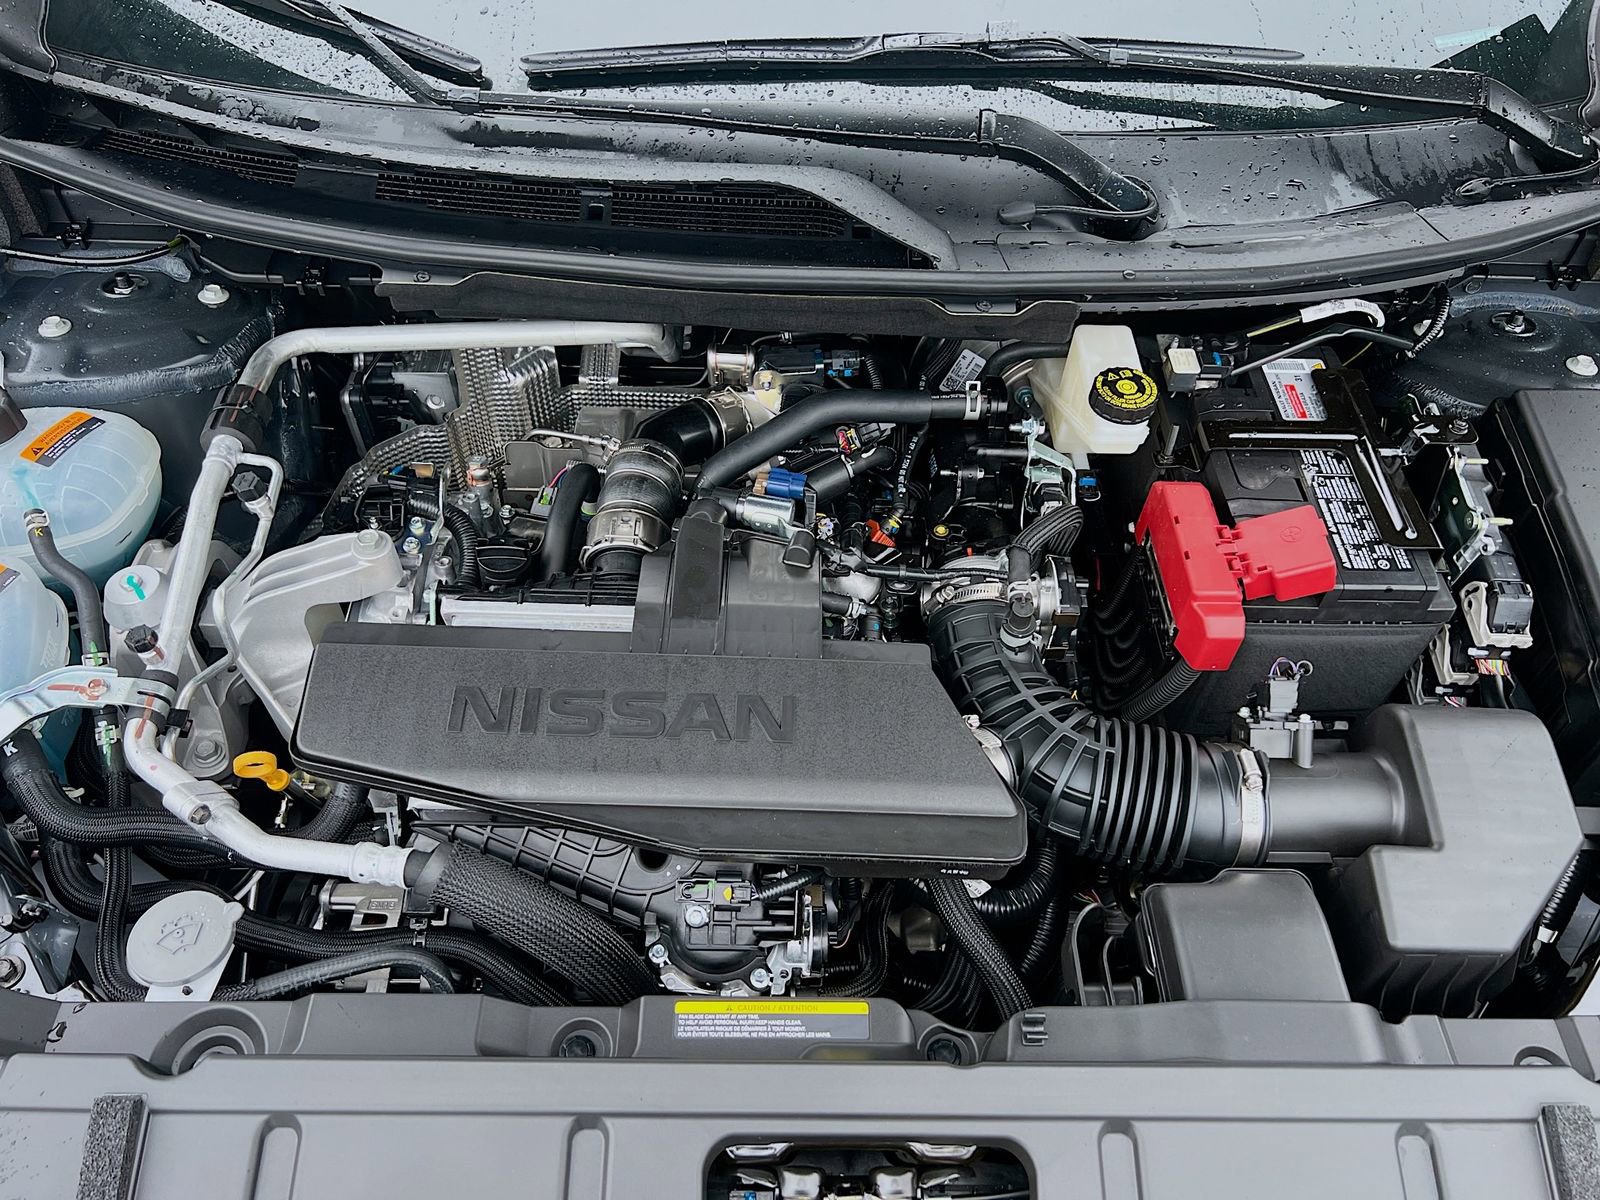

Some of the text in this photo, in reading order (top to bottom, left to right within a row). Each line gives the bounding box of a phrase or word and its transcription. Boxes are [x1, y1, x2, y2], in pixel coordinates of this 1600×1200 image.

[34, 527, 43, 537] K
[447, 687, 796, 742] NISSAN
[3, 741, 19, 757] K
[737, 1004, 769, 1012] CAUTION
[778, 1004, 818, 1012] ATTENTION
